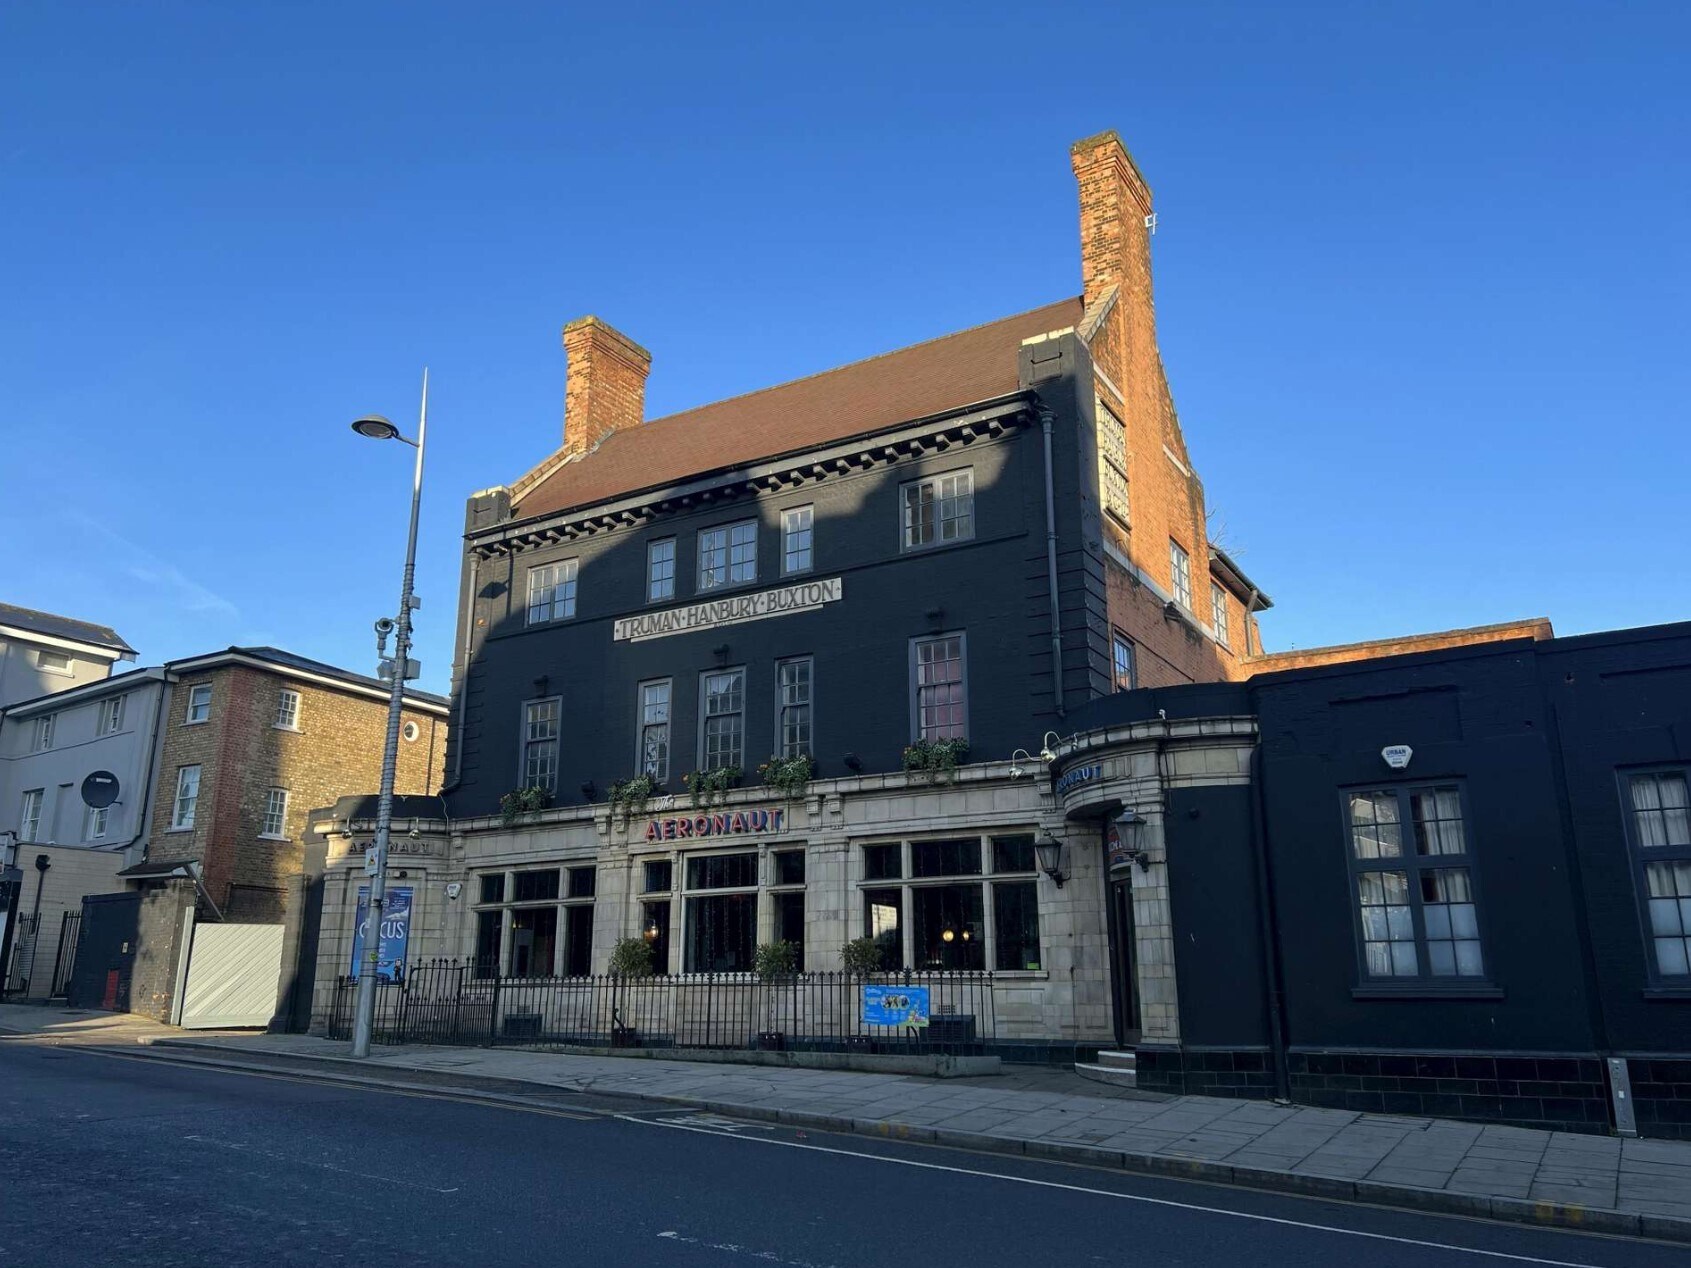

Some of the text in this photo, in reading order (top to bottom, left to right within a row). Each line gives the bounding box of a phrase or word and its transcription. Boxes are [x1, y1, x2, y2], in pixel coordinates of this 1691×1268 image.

[619, 580, 836, 639] TRUMAN HANBURY BUXTON
[645, 808, 784, 841] AERONAUT
[359, 921, 405, 939] CCUS
